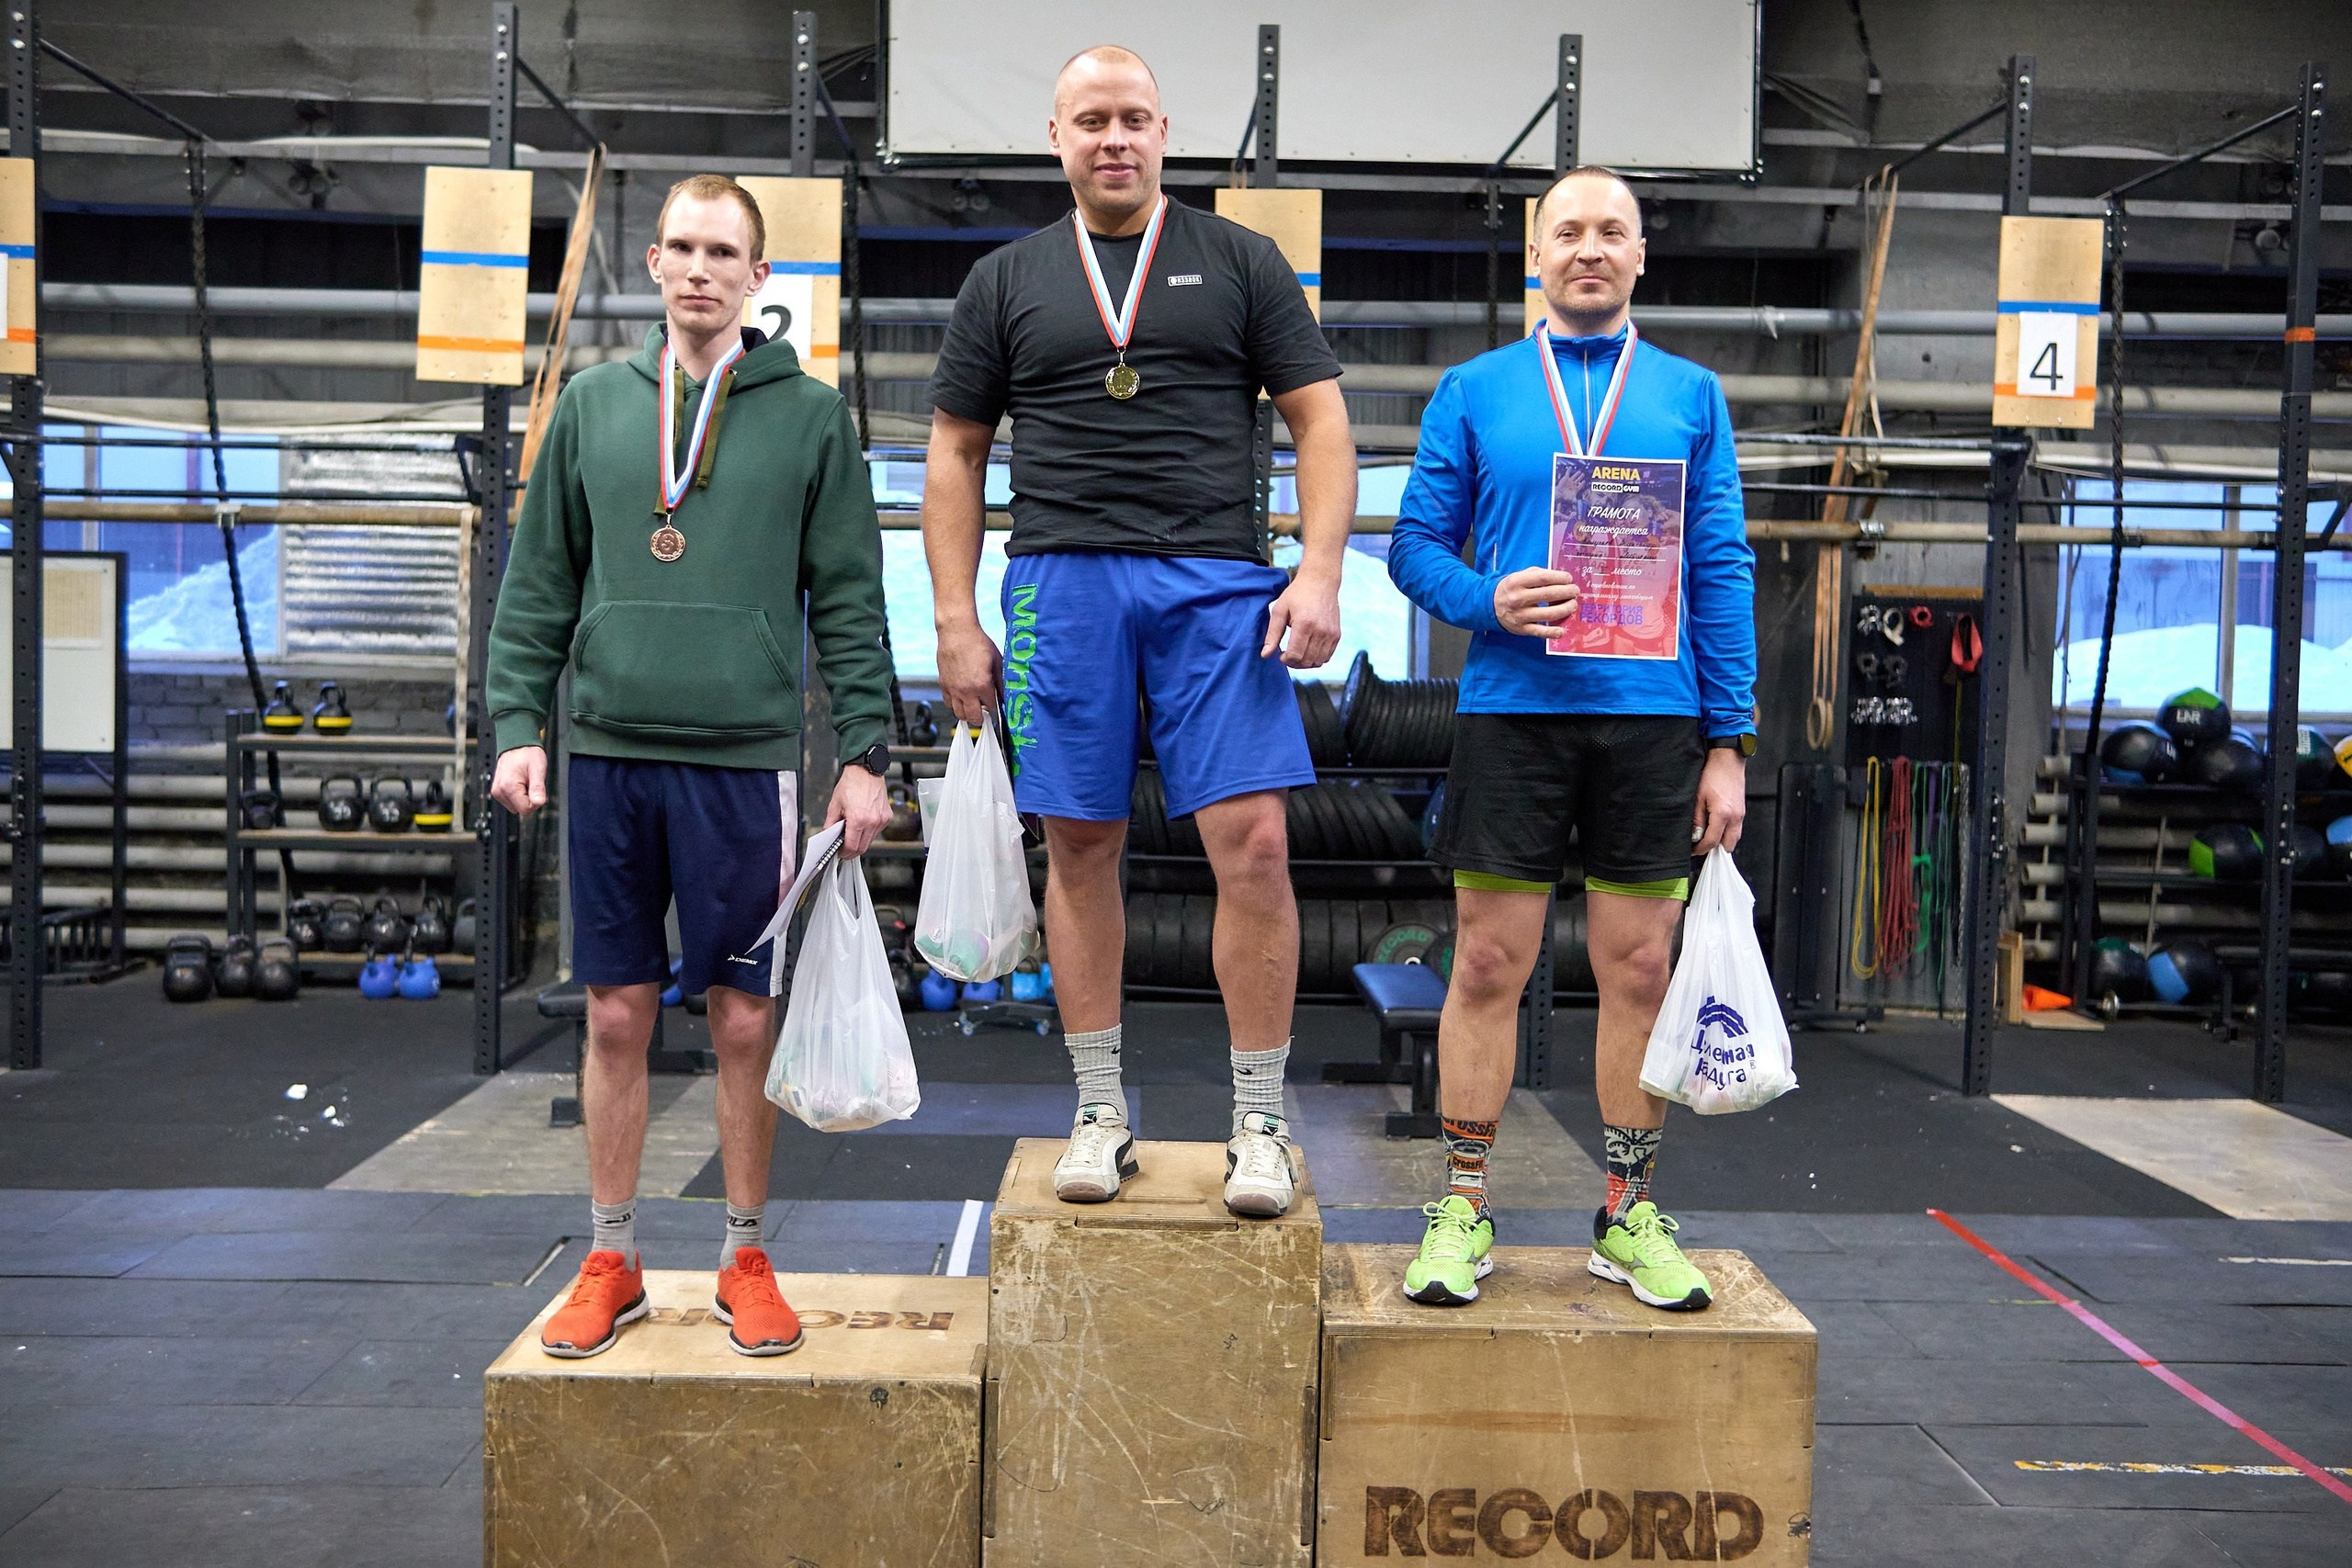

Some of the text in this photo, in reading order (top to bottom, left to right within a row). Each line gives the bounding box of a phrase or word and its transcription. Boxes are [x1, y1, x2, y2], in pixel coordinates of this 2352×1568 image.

[762, 305, 792, 343] 2
[2030, 343, 2064, 390] 4
[1591, 467, 1641, 480] ARENA
[1592, 483, 1623, 491] RECORD
[1587, 505, 1641, 520] ГРАМОТА
[1578, 525, 1649, 538] награждается
[1581, 566, 1594, 577] за
[1611, 568, 1642, 576] место
[1580, 603, 1644, 615] ТЕРРИТОРИЯ
[1580, 613, 1644, 625] РЕКОРДОВ
[1364, 1485, 1764, 1561] RECORD
